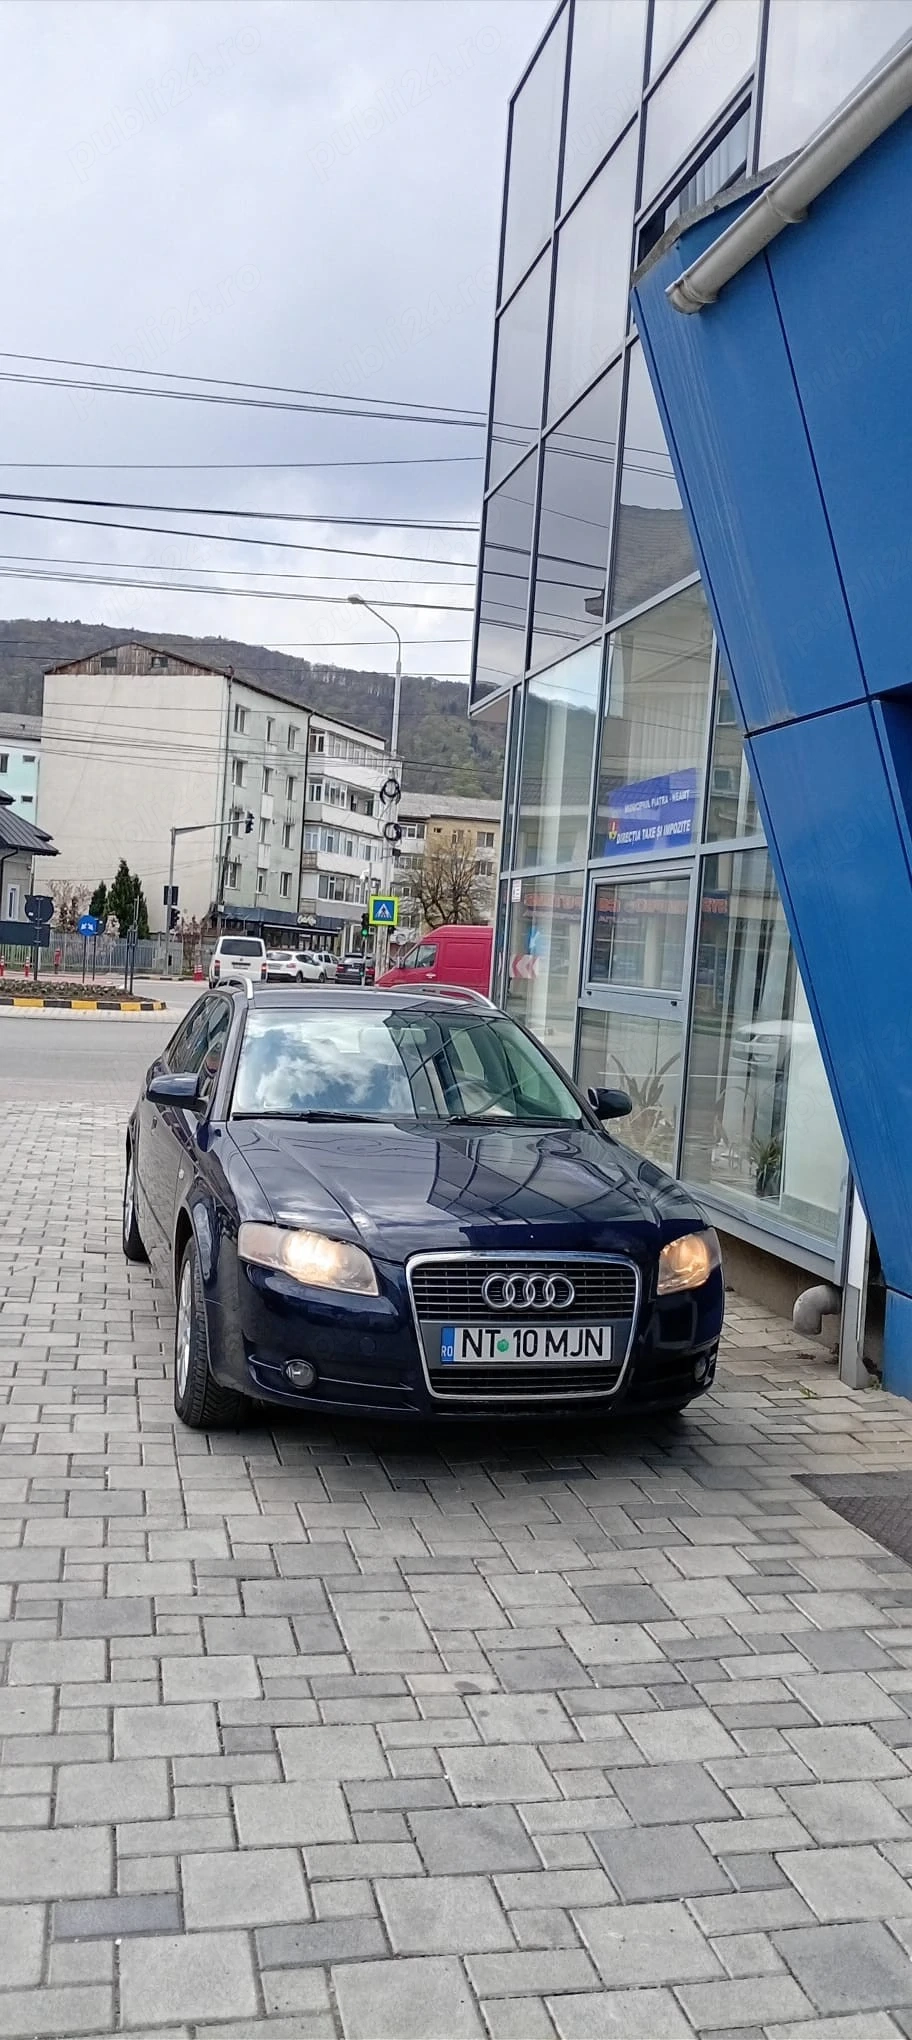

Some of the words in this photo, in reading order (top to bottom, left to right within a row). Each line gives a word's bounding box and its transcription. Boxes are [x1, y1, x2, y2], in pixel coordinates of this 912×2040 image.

[651, 795, 668, 807] PIATRA
[616, 831, 640, 845] DIRECȚIA
[642, 827, 656, 839] TAXE
[663, 820, 691, 835] IMPOZITE
[441, 1345, 454, 1357] RO
[461, 1329, 501, 1358] NT
[513, 1329, 538, 1358] 10
[545, 1328, 604, 1357] MJN
